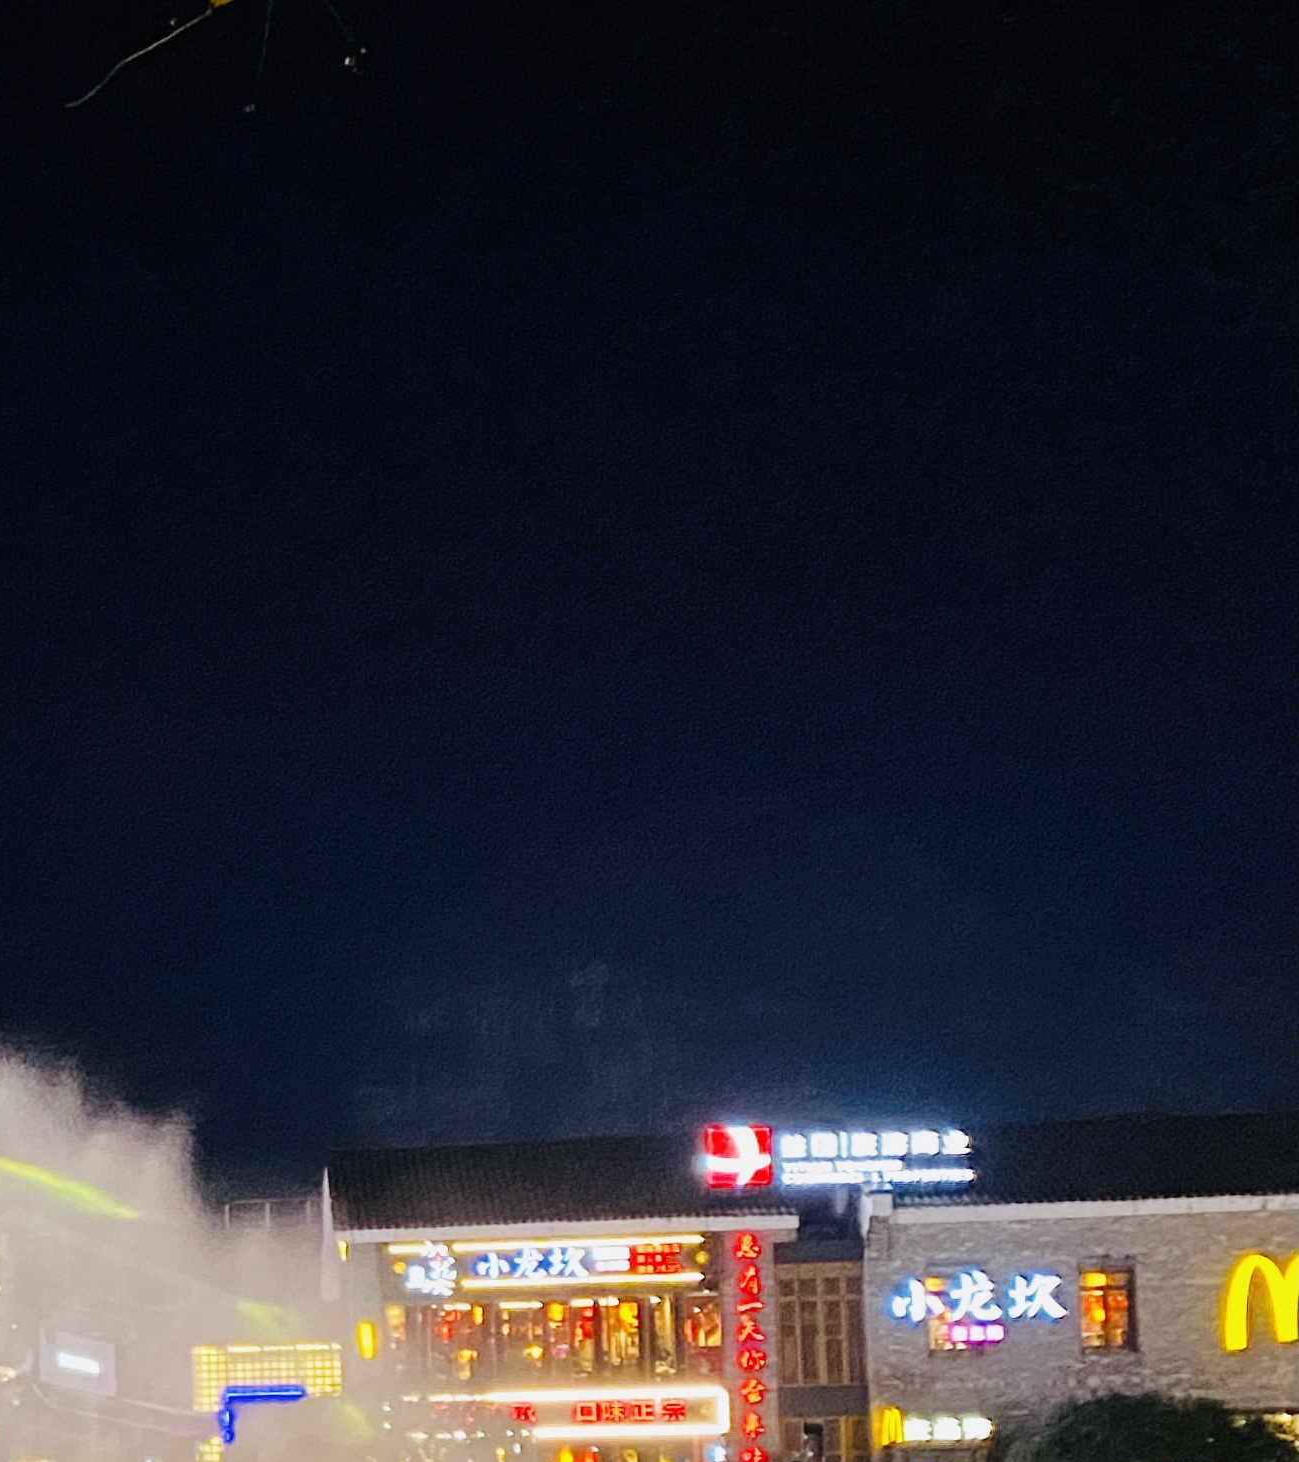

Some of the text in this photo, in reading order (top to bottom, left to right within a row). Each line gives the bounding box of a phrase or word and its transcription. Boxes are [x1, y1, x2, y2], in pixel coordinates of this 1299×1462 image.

[477, 1246, 590, 1279] 小龙坎
[891, 1269, 1070, 1323] 小龙坎
[575, 1399, 686, 1422] 口味正宗
